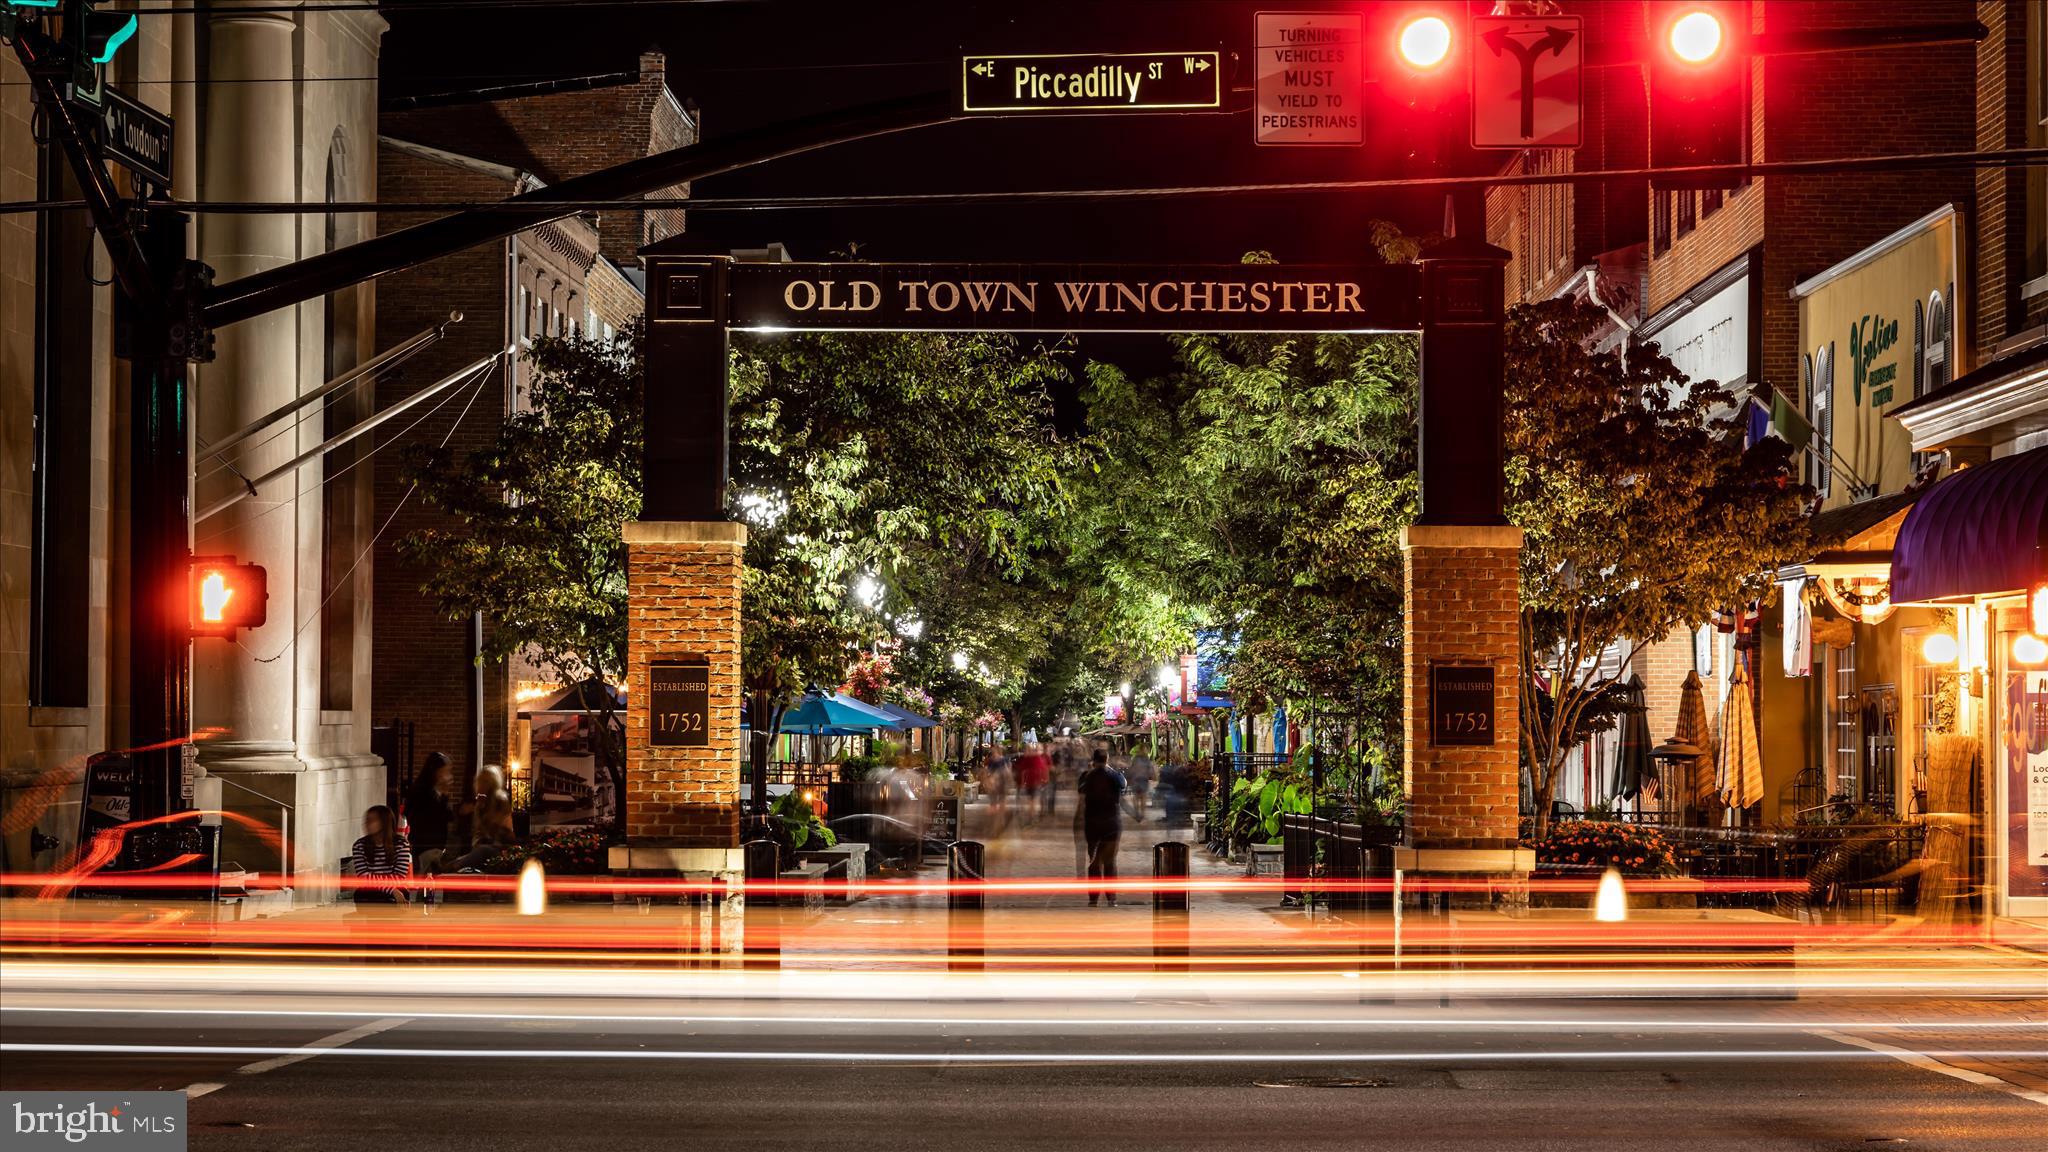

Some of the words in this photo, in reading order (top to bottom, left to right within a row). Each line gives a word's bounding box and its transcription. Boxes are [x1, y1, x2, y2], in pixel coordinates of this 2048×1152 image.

[1279, 29, 1341, 42] TURNING
[1275, 50, 1345, 62] VEHICLES
[987, 61, 995, 78] E
[1015, 65, 1142, 103] Piccadilly
[1148, 62, 1164, 79] ST
[1184, 57, 1194, 74] W
[1284, 70, 1334, 87] MUST
[1278, 94, 1318, 107] YIELD
[1326, 94, 1342, 107] TO
[1262, 115, 1358, 128] PEDESTRIANS
[123, 112, 160, 163] Loudoun
[784, 280, 881, 311] OLD
[899, 280, 1038, 312] TOWN
[1054, 281, 1366, 313] WINCHESTER
[653, 682, 707, 692] ESTABLISHED
[1438, 682, 1493, 691] ESTABLISHED
[659, 712, 702, 733] 1752
[1445, 712, 1488, 733] 1752
[97, 771, 131, 783] WELC
